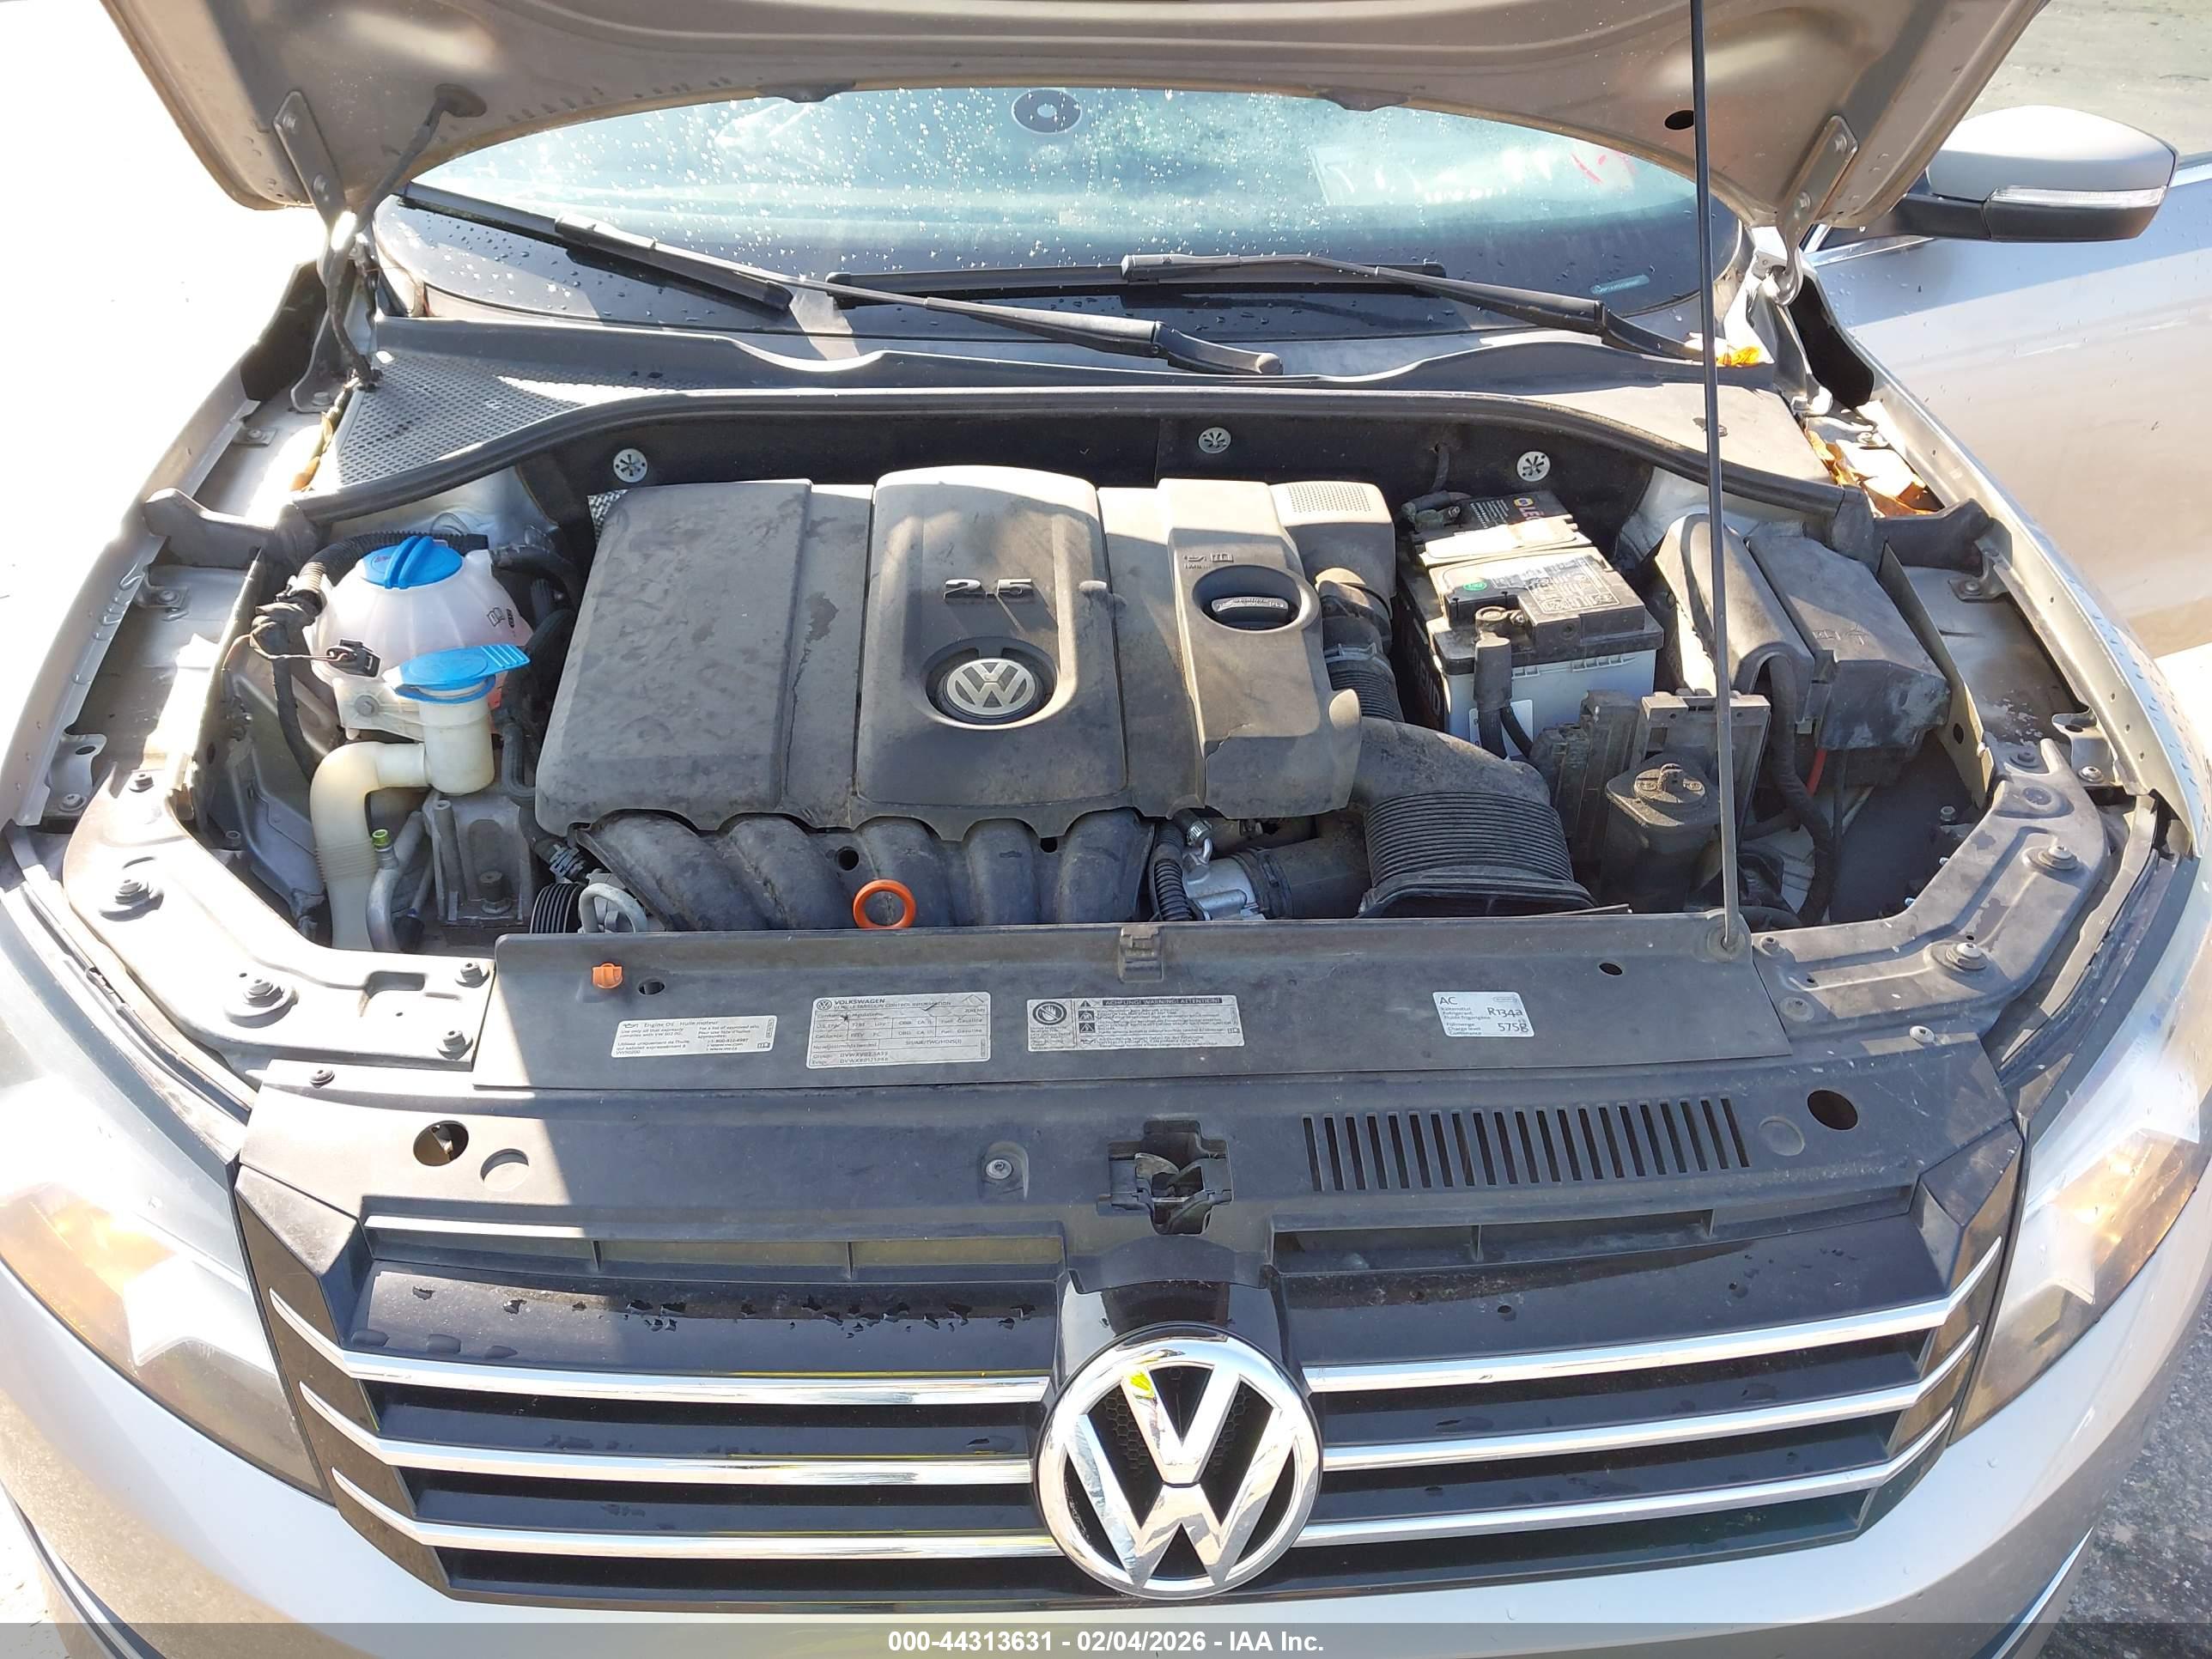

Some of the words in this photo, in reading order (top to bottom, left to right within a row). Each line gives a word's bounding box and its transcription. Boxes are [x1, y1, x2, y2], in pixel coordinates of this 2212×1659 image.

[944, 578, 1033, 599] 2.5
[1440, 997, 1458, 1005] AC
[1487, 1007, 1523, 1018] R134a
